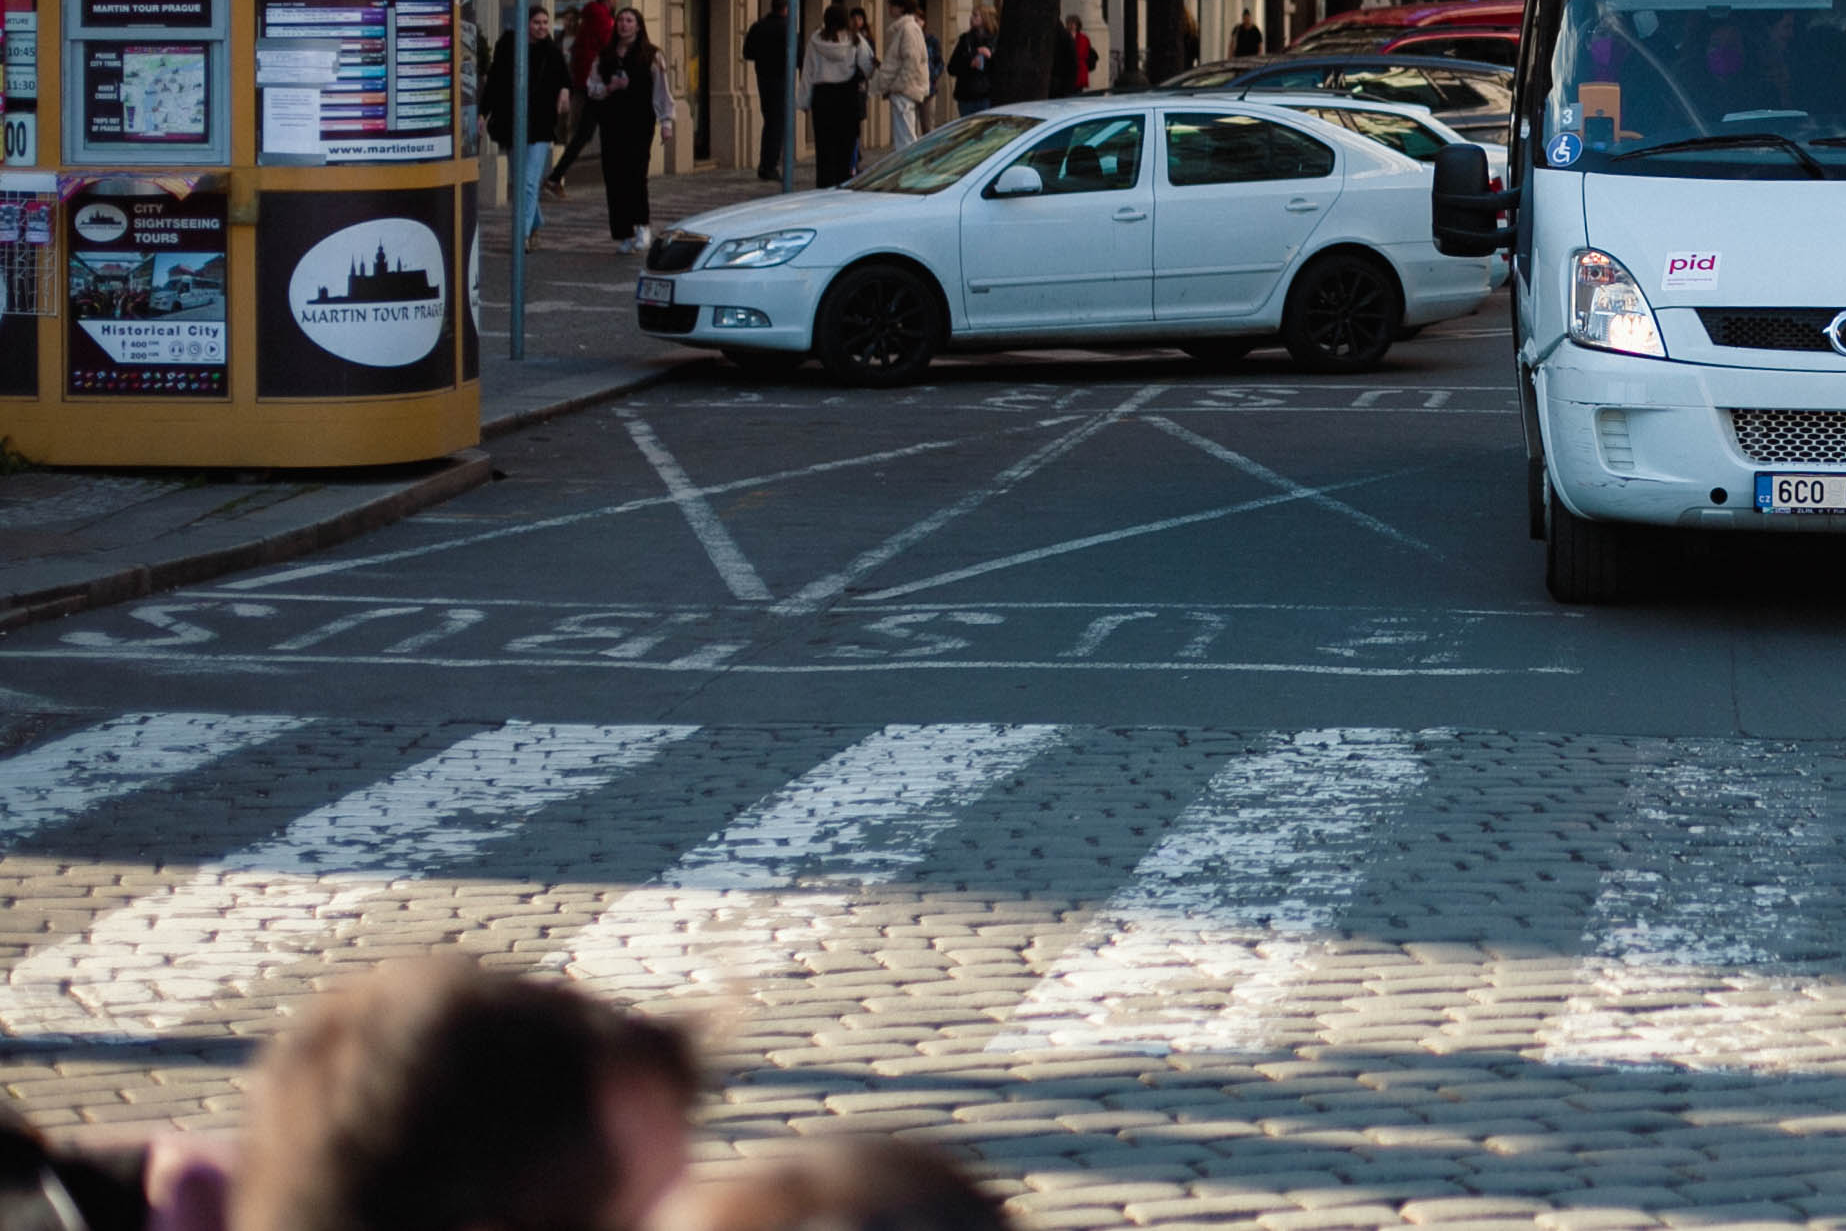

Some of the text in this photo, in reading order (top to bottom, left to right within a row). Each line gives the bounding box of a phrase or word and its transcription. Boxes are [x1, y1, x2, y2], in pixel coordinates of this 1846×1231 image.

[93, 4, 201, 13] MARTIN TOUR PRAGUE
[7, 46, 36, 57] 10:45
[6, 79, 36, 91] 11:30
[1562, 108, 1573, 124] 3
[329, 144, 435, 155] www.martintour.cz
[134, 204, 163, 214] CITY
[134, 218, 220, 229] SIGHTSEEING
[134, 232, 179, 244] TOURS
[1668, 254, 1716, 275] pid
[301, 308, 366, 324] MARTIN
[371, 306, 409, 322] TOUR
[101, 325, 219, 338] Historical City
[1758, 495, 1771, 503] CZ
